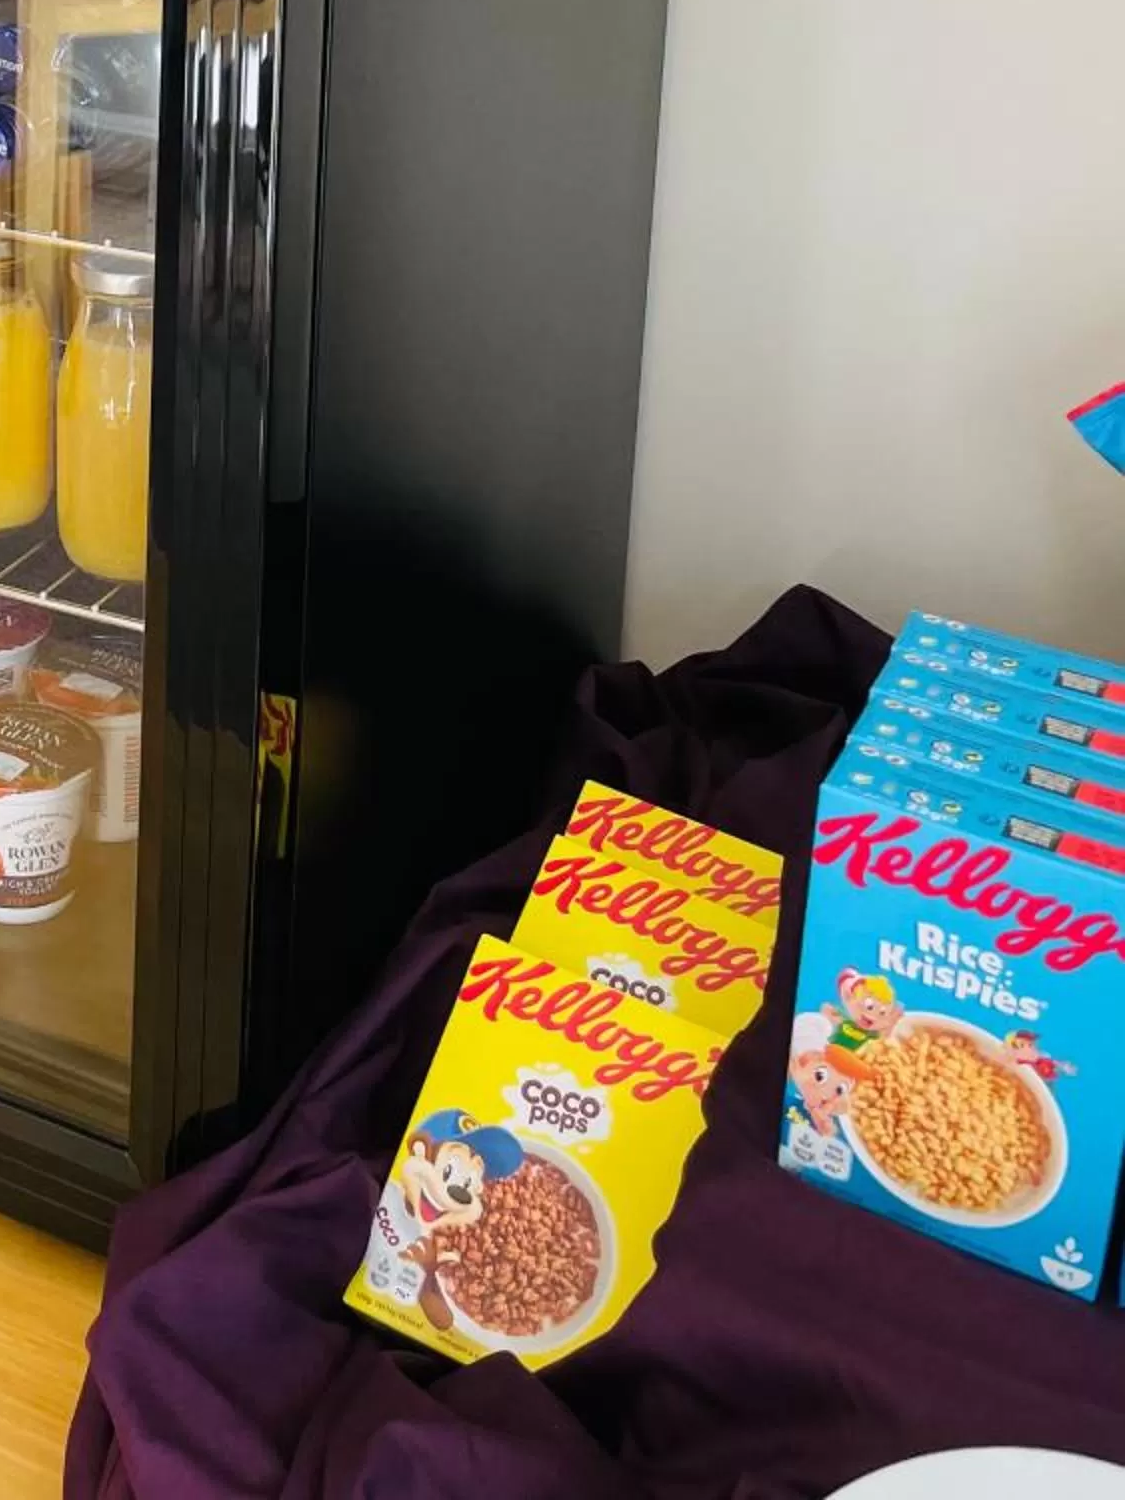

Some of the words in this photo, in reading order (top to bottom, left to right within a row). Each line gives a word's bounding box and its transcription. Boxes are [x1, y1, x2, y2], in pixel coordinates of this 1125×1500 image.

[8, 839, 66, 860] ROWAN
[15, 854, 60, 873] GLEN
[565, 796, 780, 916] Kellogg
[532, 855, 769, 992] Kellogg
[811, 812, 1125, 972] Kellogg
[878, 939, 1042, 1022] Krispies
[916, 920, 1004, 976] Rice
[528, 1104, 589, 1135] pops
